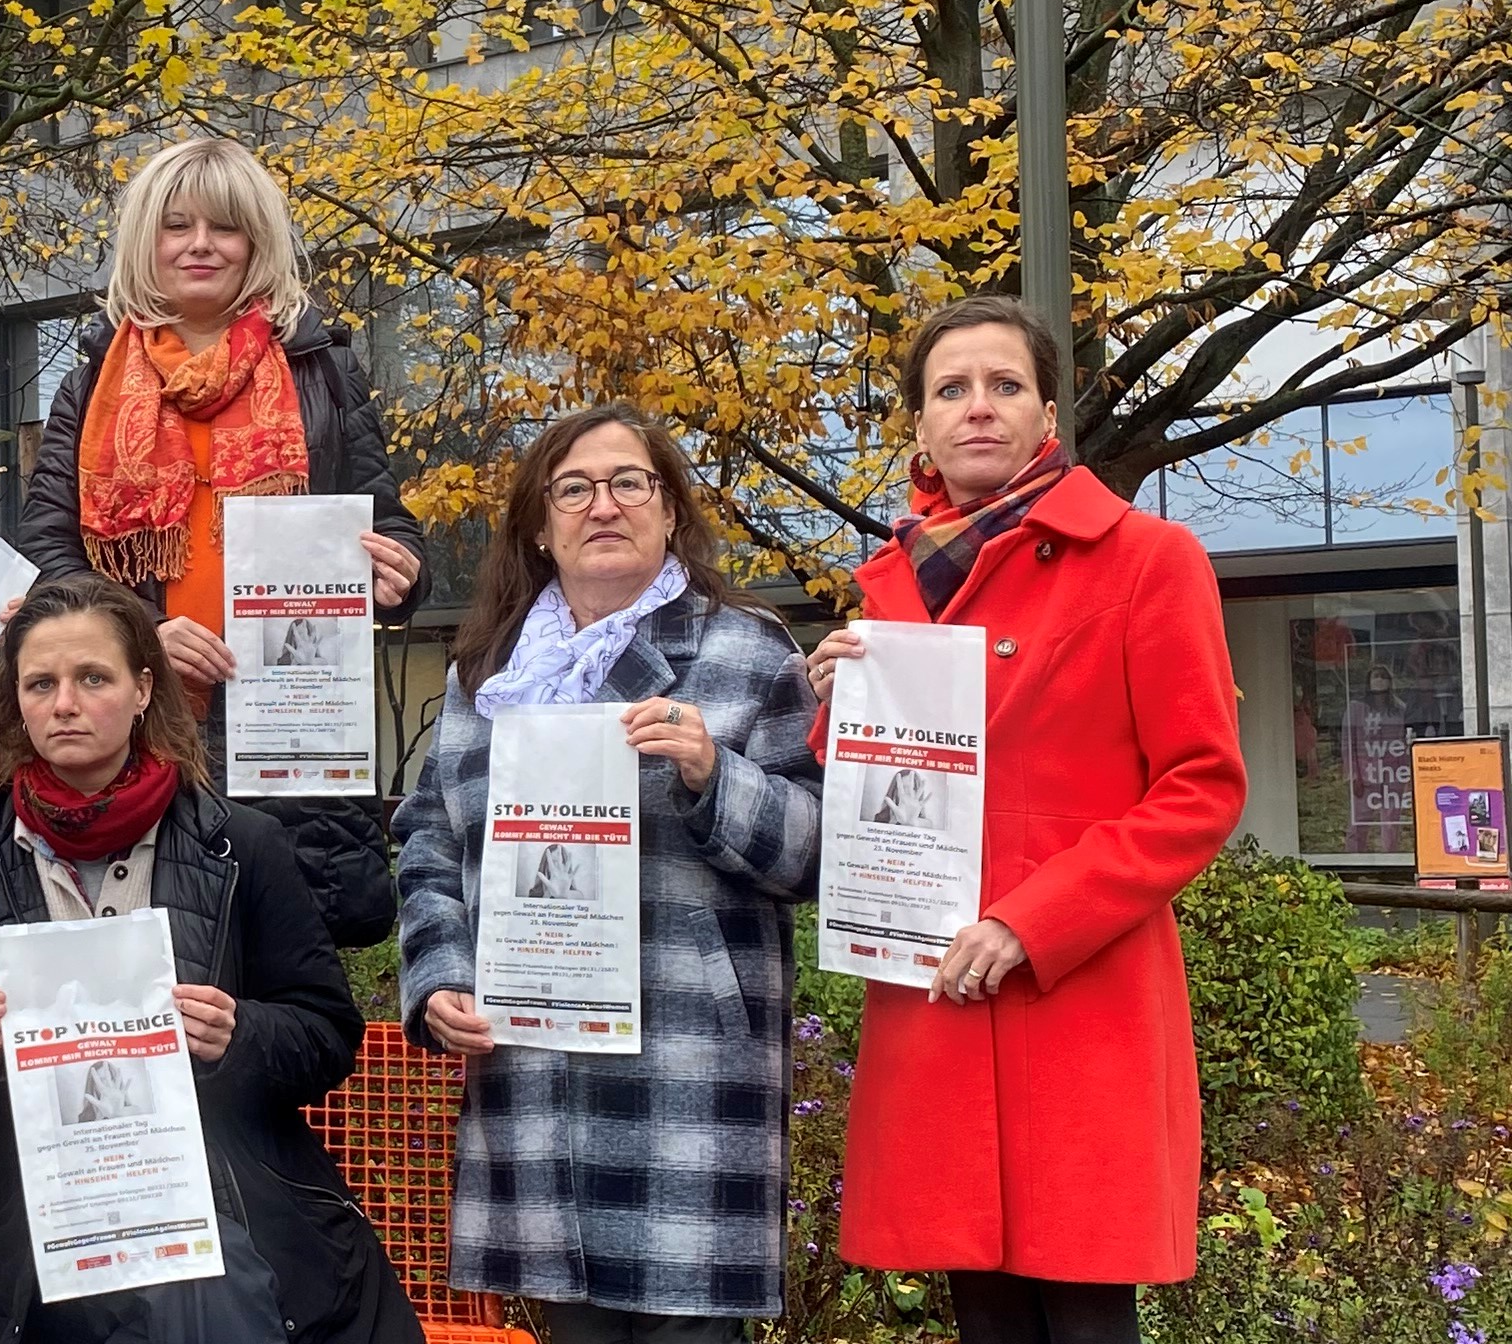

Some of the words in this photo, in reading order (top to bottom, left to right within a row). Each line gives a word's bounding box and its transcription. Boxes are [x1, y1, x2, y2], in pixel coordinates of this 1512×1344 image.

[233, 584, 276, 595] STOP
[838, 721, 885, 738] STOP
[890, 747, 928, 757] GEWALT
[837, 751, 871, 760] KOMMT
[895, 756, 923, 765] NICHT
[954, 762, 974, 772] TÜTE
[1367, 785, 1413, 810] cha
[494, 804, 533, 816] STOP
[603, 833, 627, 841] TÜTE
[13, 1025, 68, 1044] STOP
[77, 1039, 116, 1049] GEWALT
[20, 1055, 58, 1067] KOMMT
[61, 1052, 81, 1061] MIR
[84, 1048, 113, 1058] NICHT
[130, 1046, 146, 1054] DIE
[149, 1042, 176, 1052] TÜTE
